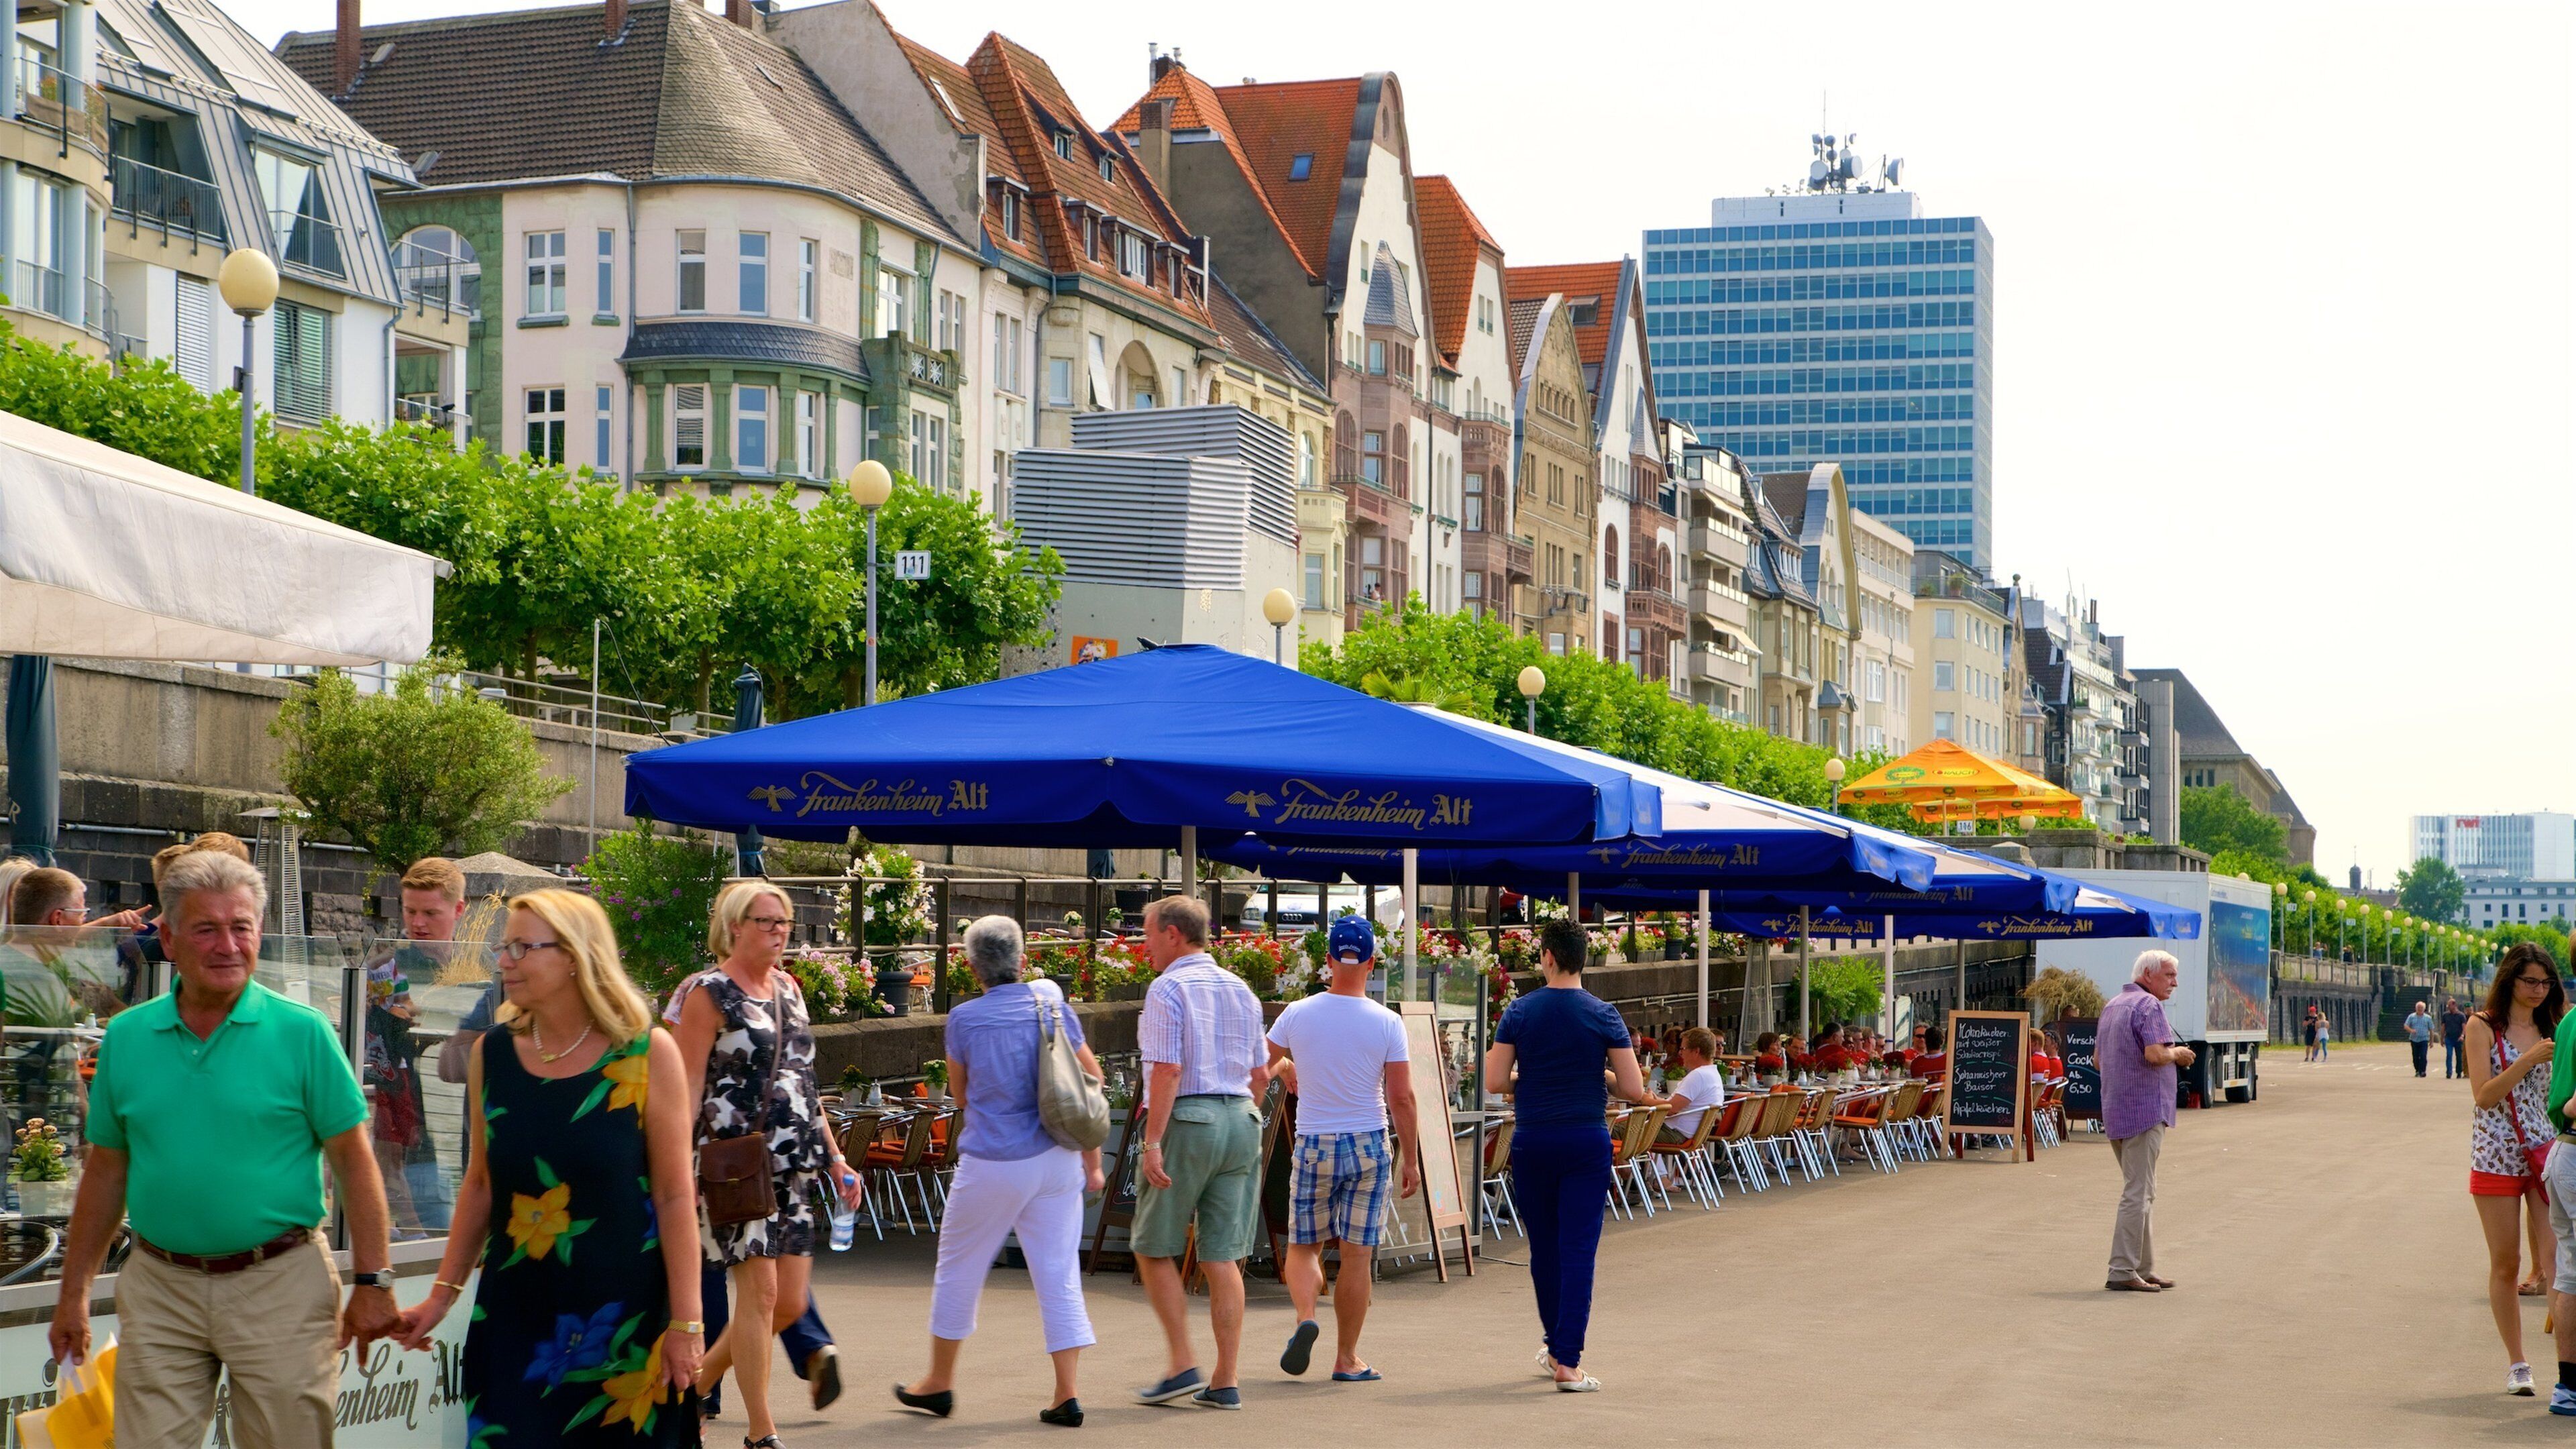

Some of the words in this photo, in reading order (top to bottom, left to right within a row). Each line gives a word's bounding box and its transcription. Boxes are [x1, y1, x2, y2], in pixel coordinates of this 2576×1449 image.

[902, 555, 924, 574] 111
[796, 771, 943, 818] Frankenheim
[947, 780, 989, 811] Alt
[1275, 778, 1426, 830] Frankenheim
[1429, 794, 1474, 826] Alt
[1621, 838, 1727, 869] Frankenheim
[1729, 843, 1761, 865] Alt
[1953, 885, 1974, 902] Alt
[1854, 919, 1874, 934] Alt
[2001, 916, 2072, 935] Frankenheim
[2074, 919, 2093, 932] Alt
[2068, 1053, 2094, 1067] Cock
[2069, 1082, 2092, 1095] 6,50
